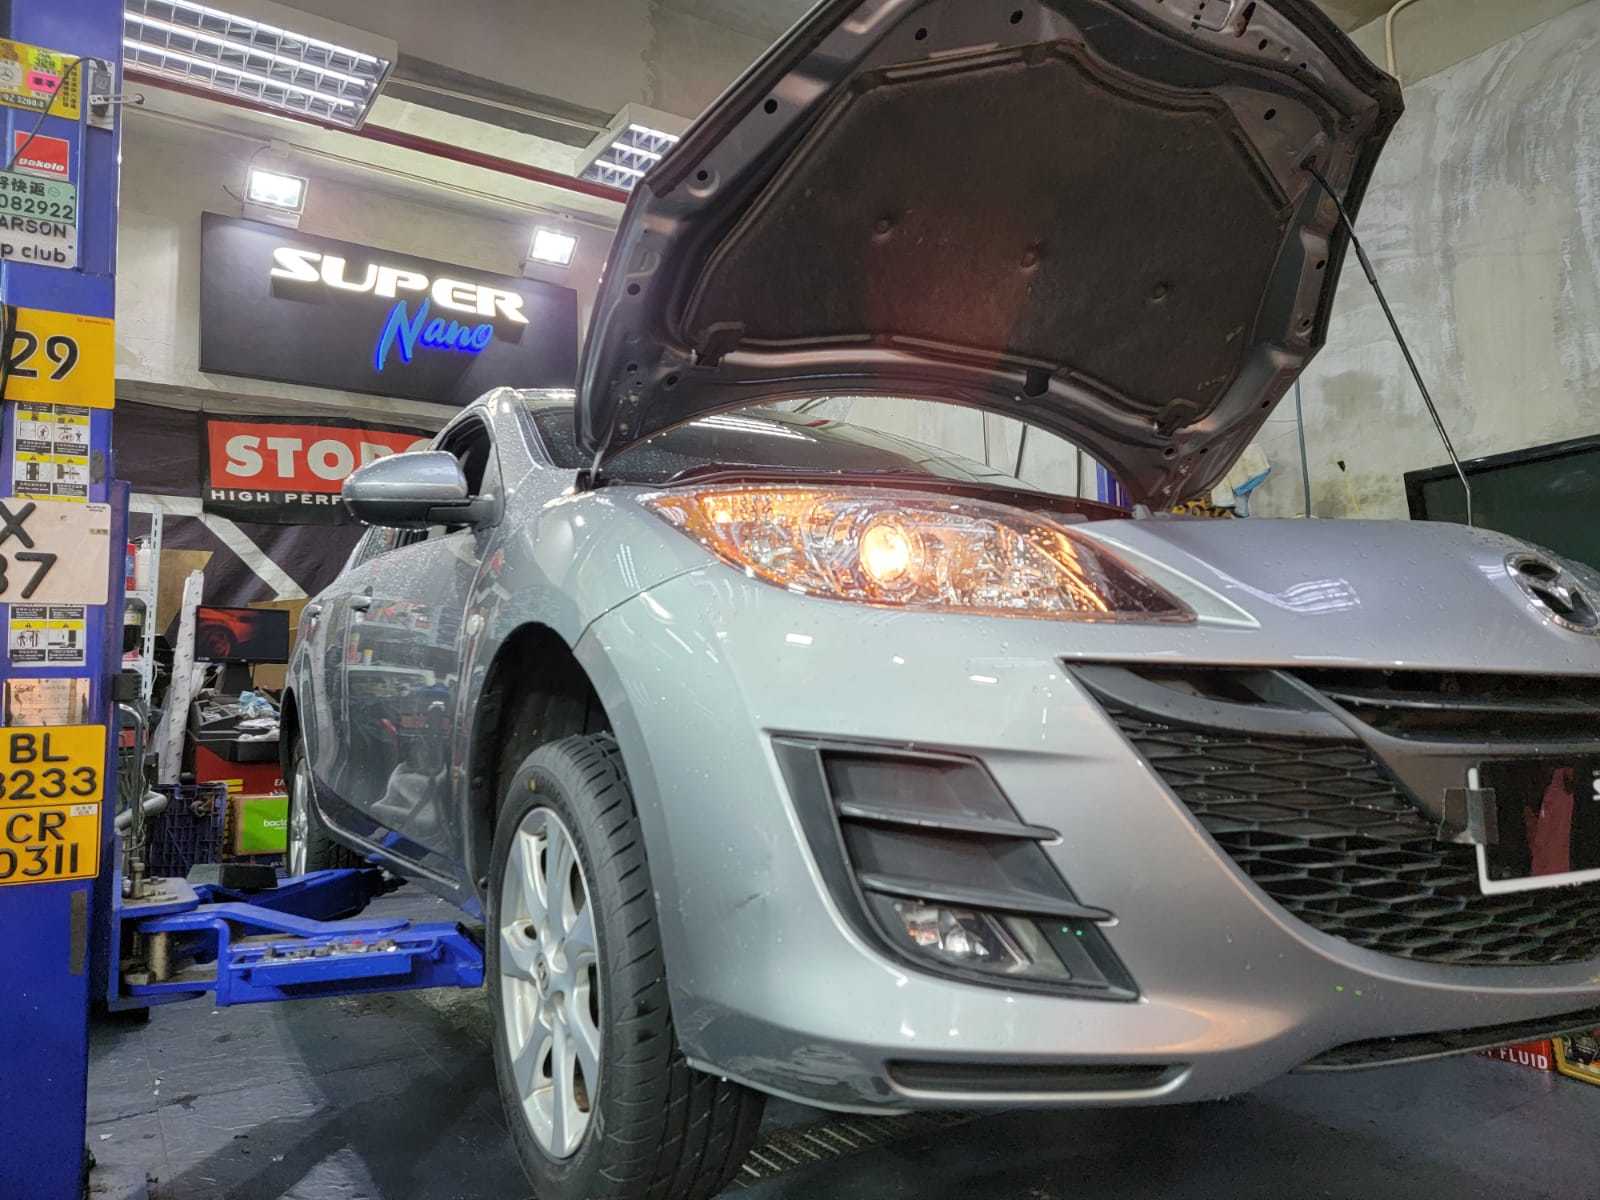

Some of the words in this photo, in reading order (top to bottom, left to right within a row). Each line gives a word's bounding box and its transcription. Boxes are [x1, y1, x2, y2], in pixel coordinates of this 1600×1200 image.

[21, 244, 66, 263] club
[270, 247, 530, 323] SUPER
[374, 296, 494, 371] Nano
[9, 330, 79, 381] 29
[225, 434, 433, 481] STO
[211, 489, 270, 503] HIGH
[0, 502, 36, 549] X
[10, 732, 69, 764] BL
[0, 766, 97, 801] 233
[6, 811, 66, 844] CR
[1500, 1047, 1548, 1070] FLUID
